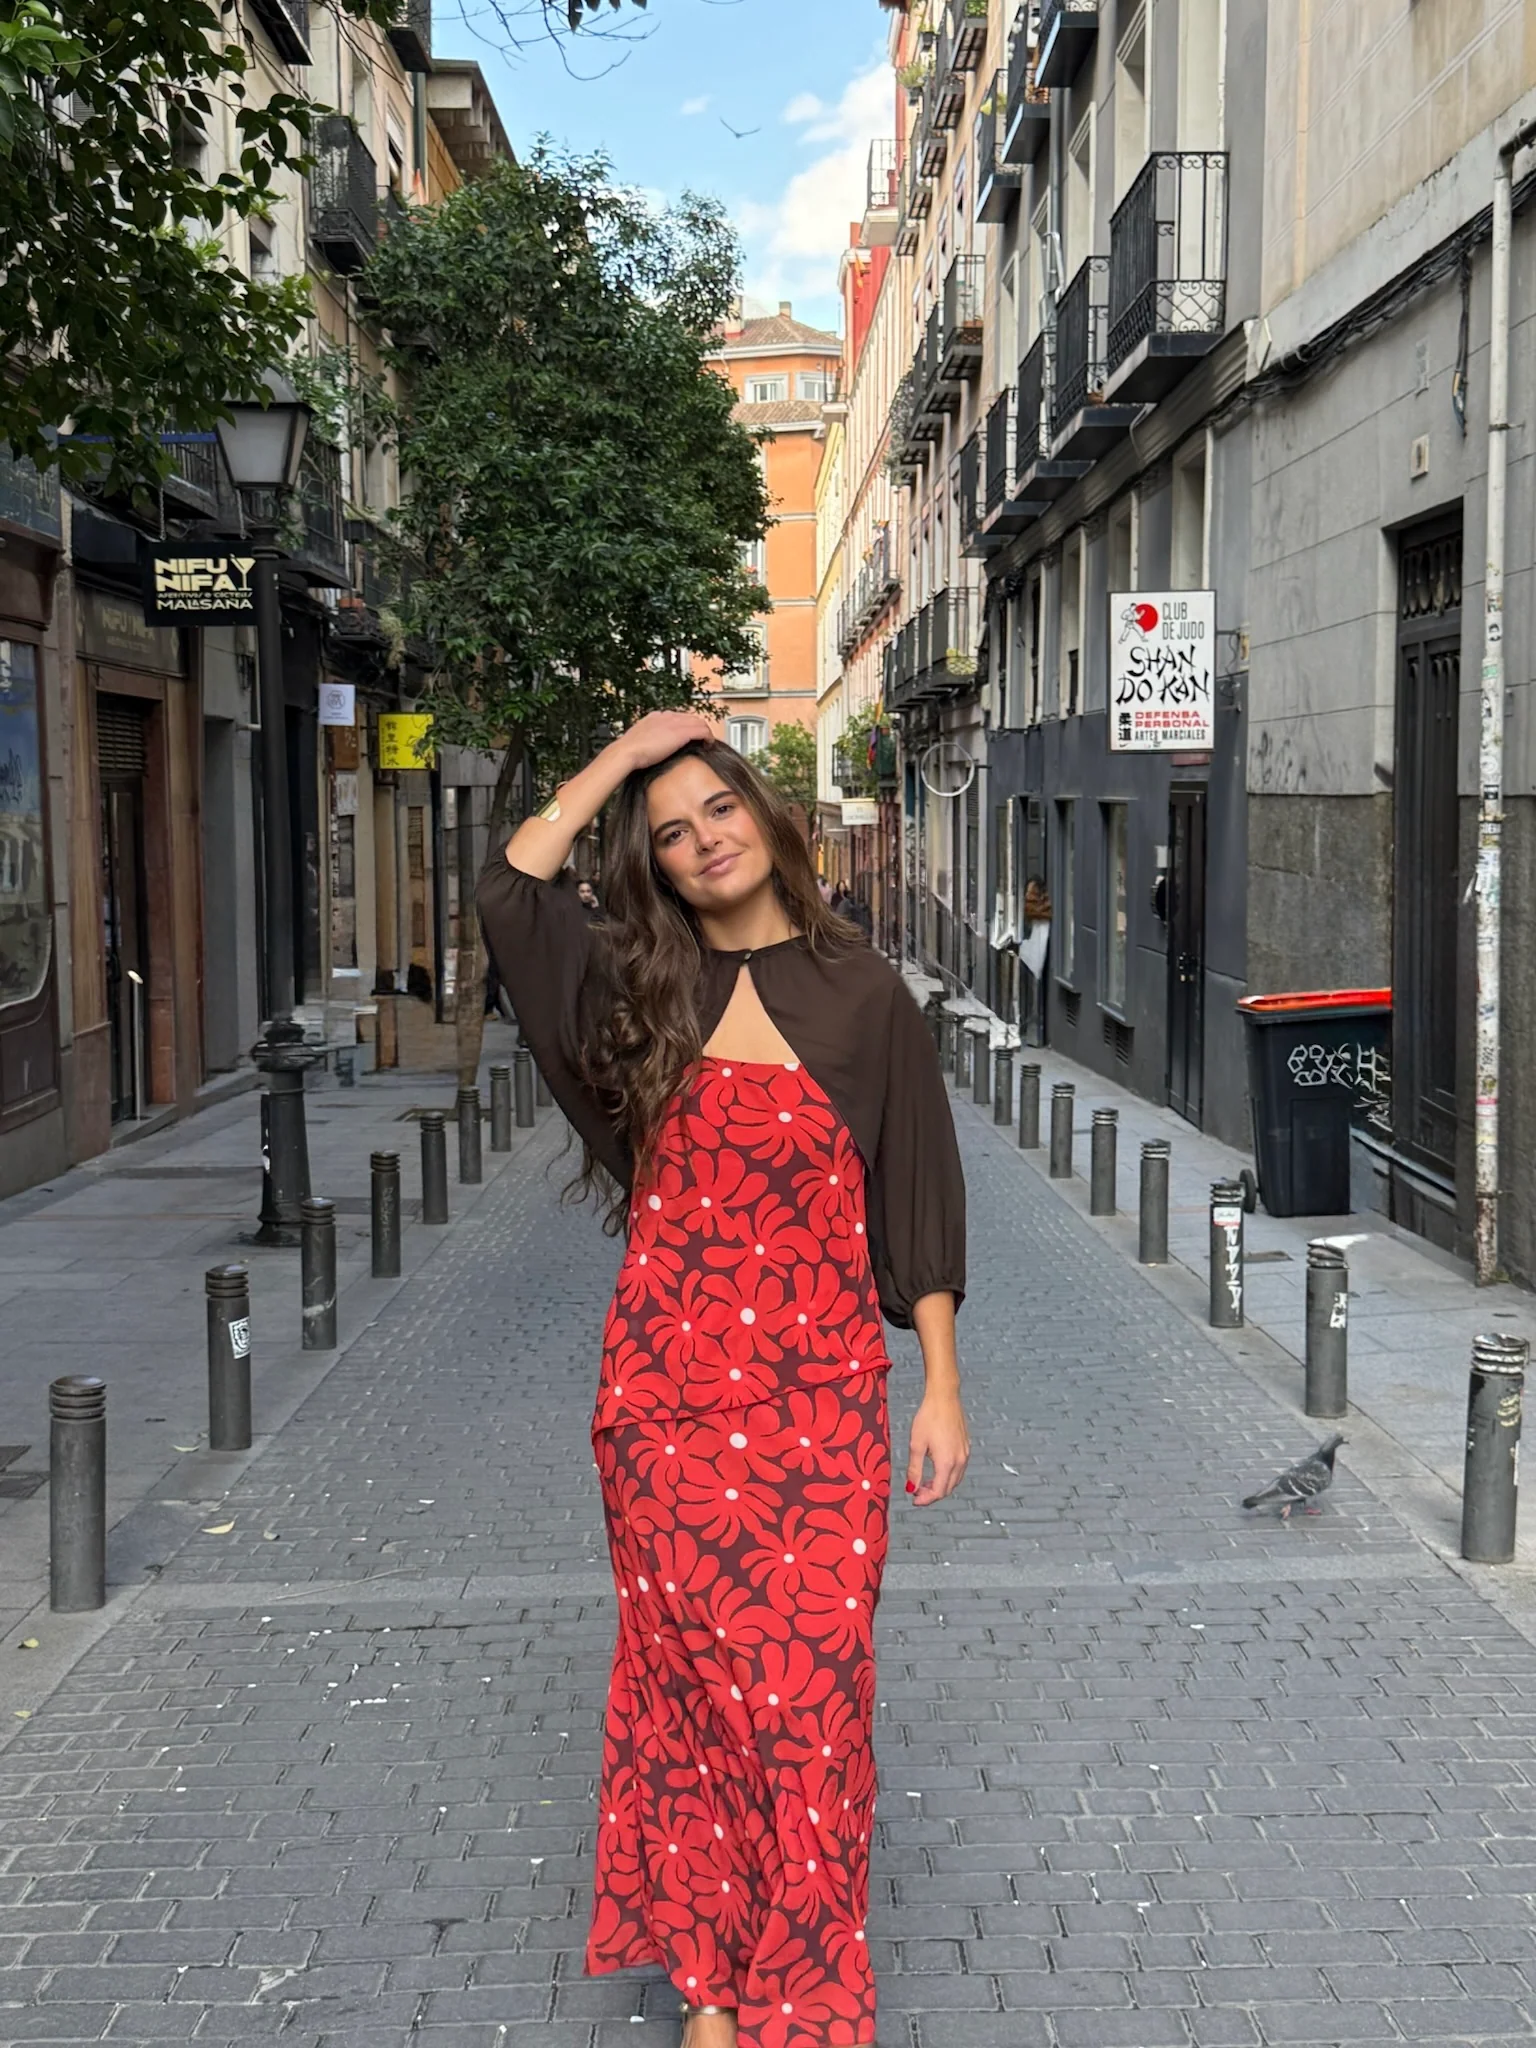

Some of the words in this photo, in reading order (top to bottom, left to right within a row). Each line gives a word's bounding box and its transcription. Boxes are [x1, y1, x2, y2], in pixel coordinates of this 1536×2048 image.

[154, 558, 228, 574] NIFU
[156, 574, 237, 592] NIFA
[1162, 602, 1188, 620] CLUB
[1162, 622, 1175, 640] DE
[1177, 621, 1205, 640] JUDO
[1126, 643, 1197, 680] SHAN
[1115, 673, 1154, 706] DO
[1157, 668, 1210, 706] KAN
[1135, 720, 1210, 729] PERSONAL
[1134, 730, 1159, 741] ARTES
[1162, 729, 1206, 741] MARCIALES
